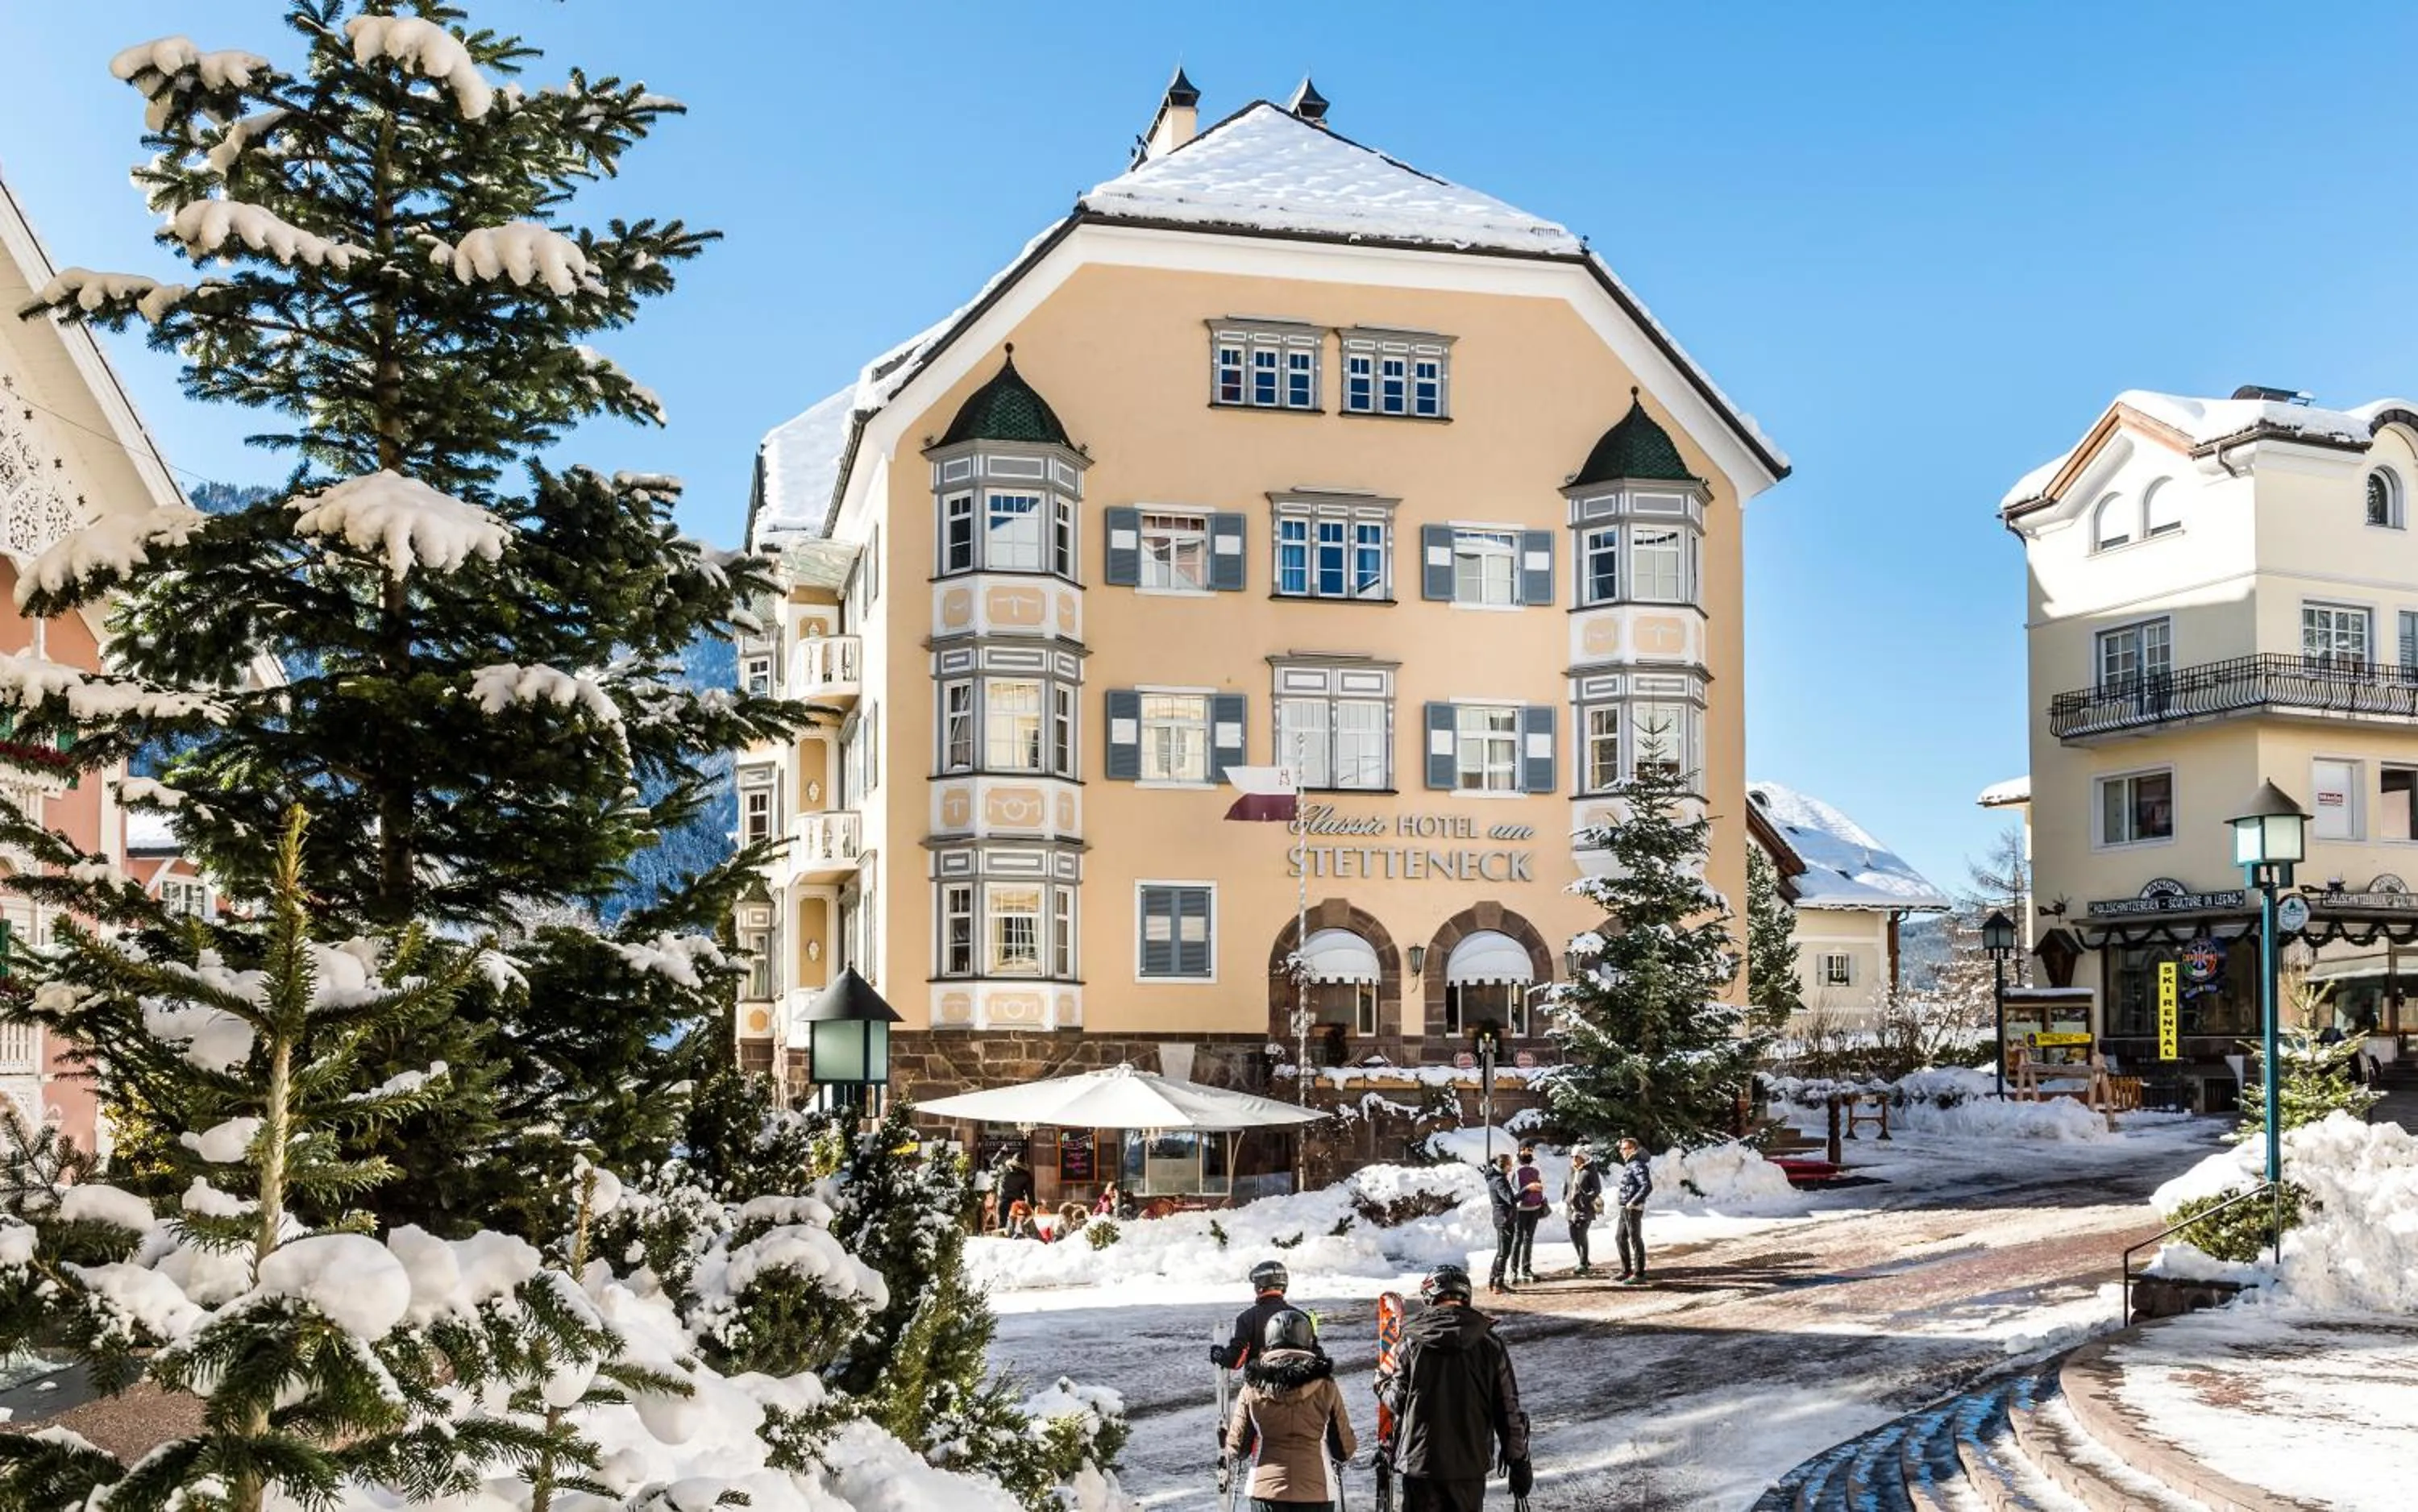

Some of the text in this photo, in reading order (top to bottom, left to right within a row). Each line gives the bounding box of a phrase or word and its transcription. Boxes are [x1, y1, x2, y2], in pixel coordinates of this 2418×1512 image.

[1288, 803, 1387, 836] Classic
[1397, 815, 1479, 839] HOTEL
[1287, 846, 1533, 883] STETTENECK
[2204, 895, 2212, 906] IN
[2162, 966, 2173, 1057] SKI RENTAL
